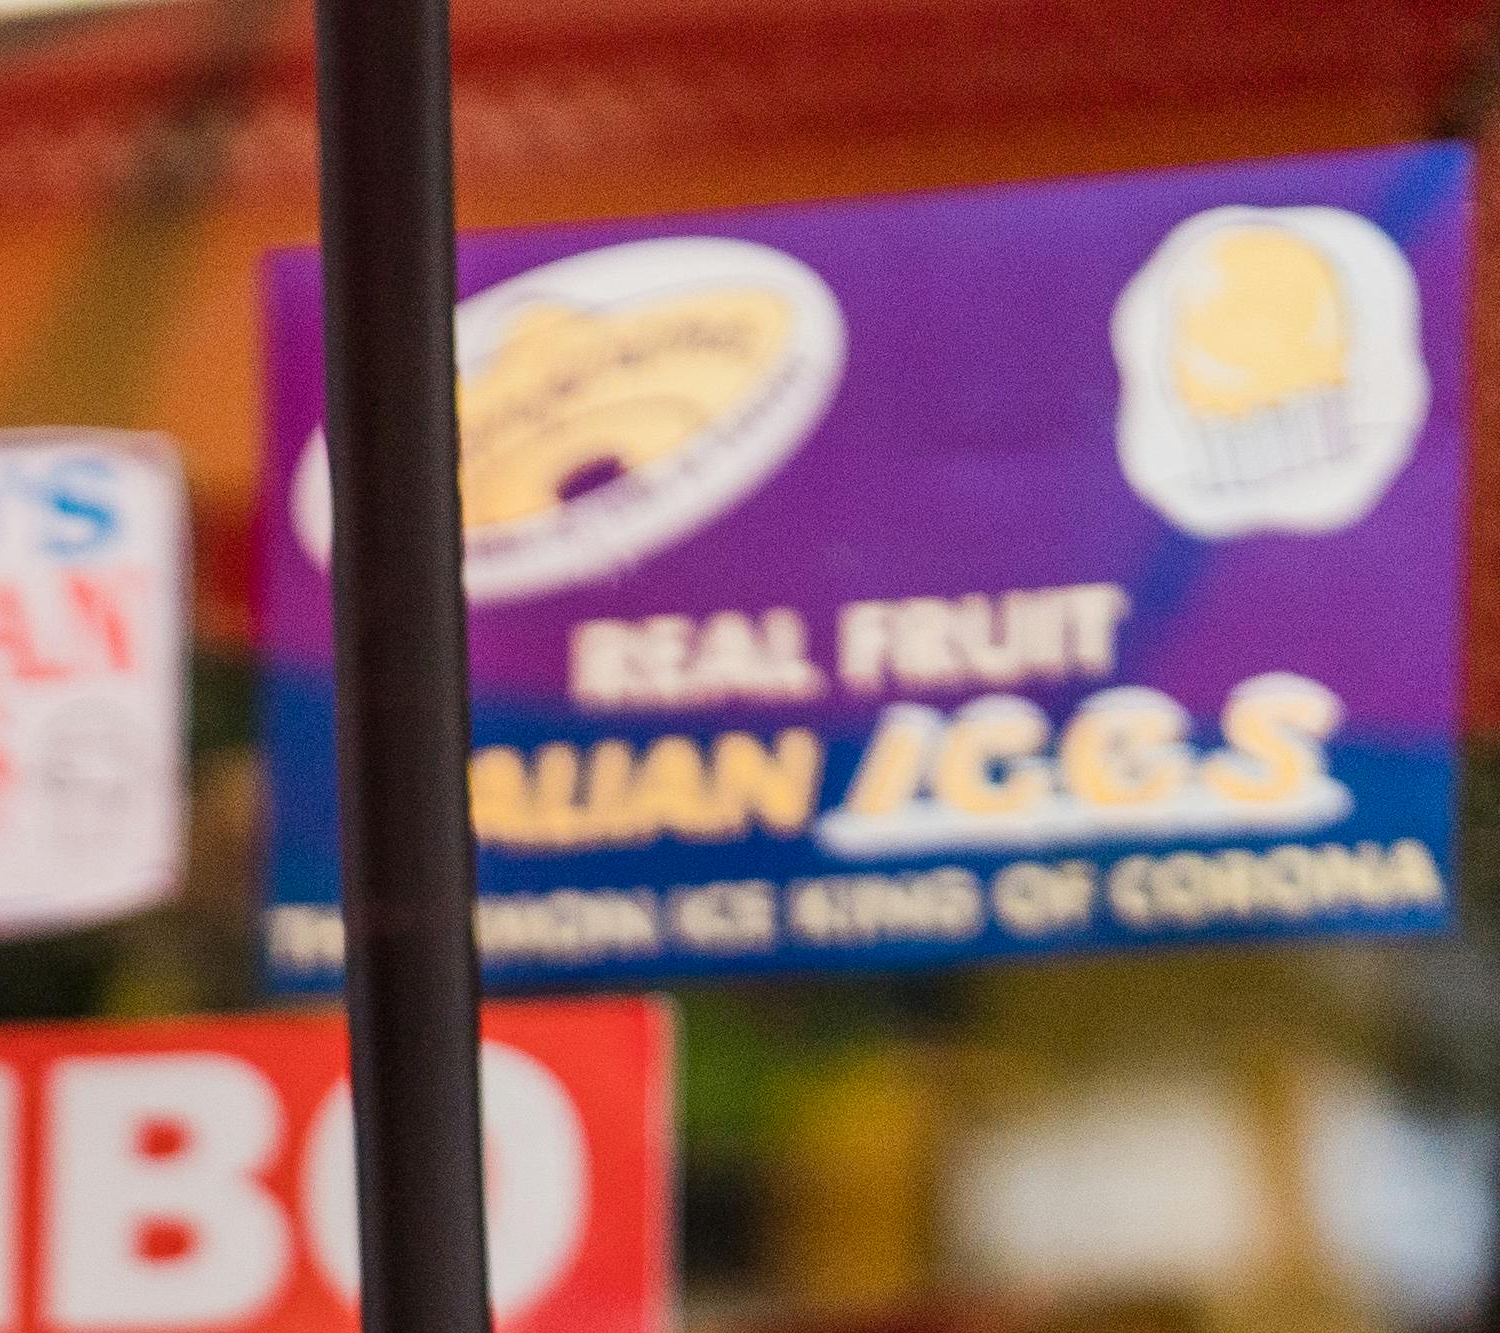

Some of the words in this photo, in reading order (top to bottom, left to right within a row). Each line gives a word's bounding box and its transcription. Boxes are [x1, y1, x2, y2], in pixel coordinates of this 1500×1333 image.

[569, 607, 823, 711] REAL
[838, 583, 1129, 691] FRUIT
[470, 728, 823, 852] ALIAN
[266, 901, 345, 972] TH
[787, 865, 984, 949] KING
[991, 855, 1098, 938] OF
[1107, 837, 1444, 930] CORONA
